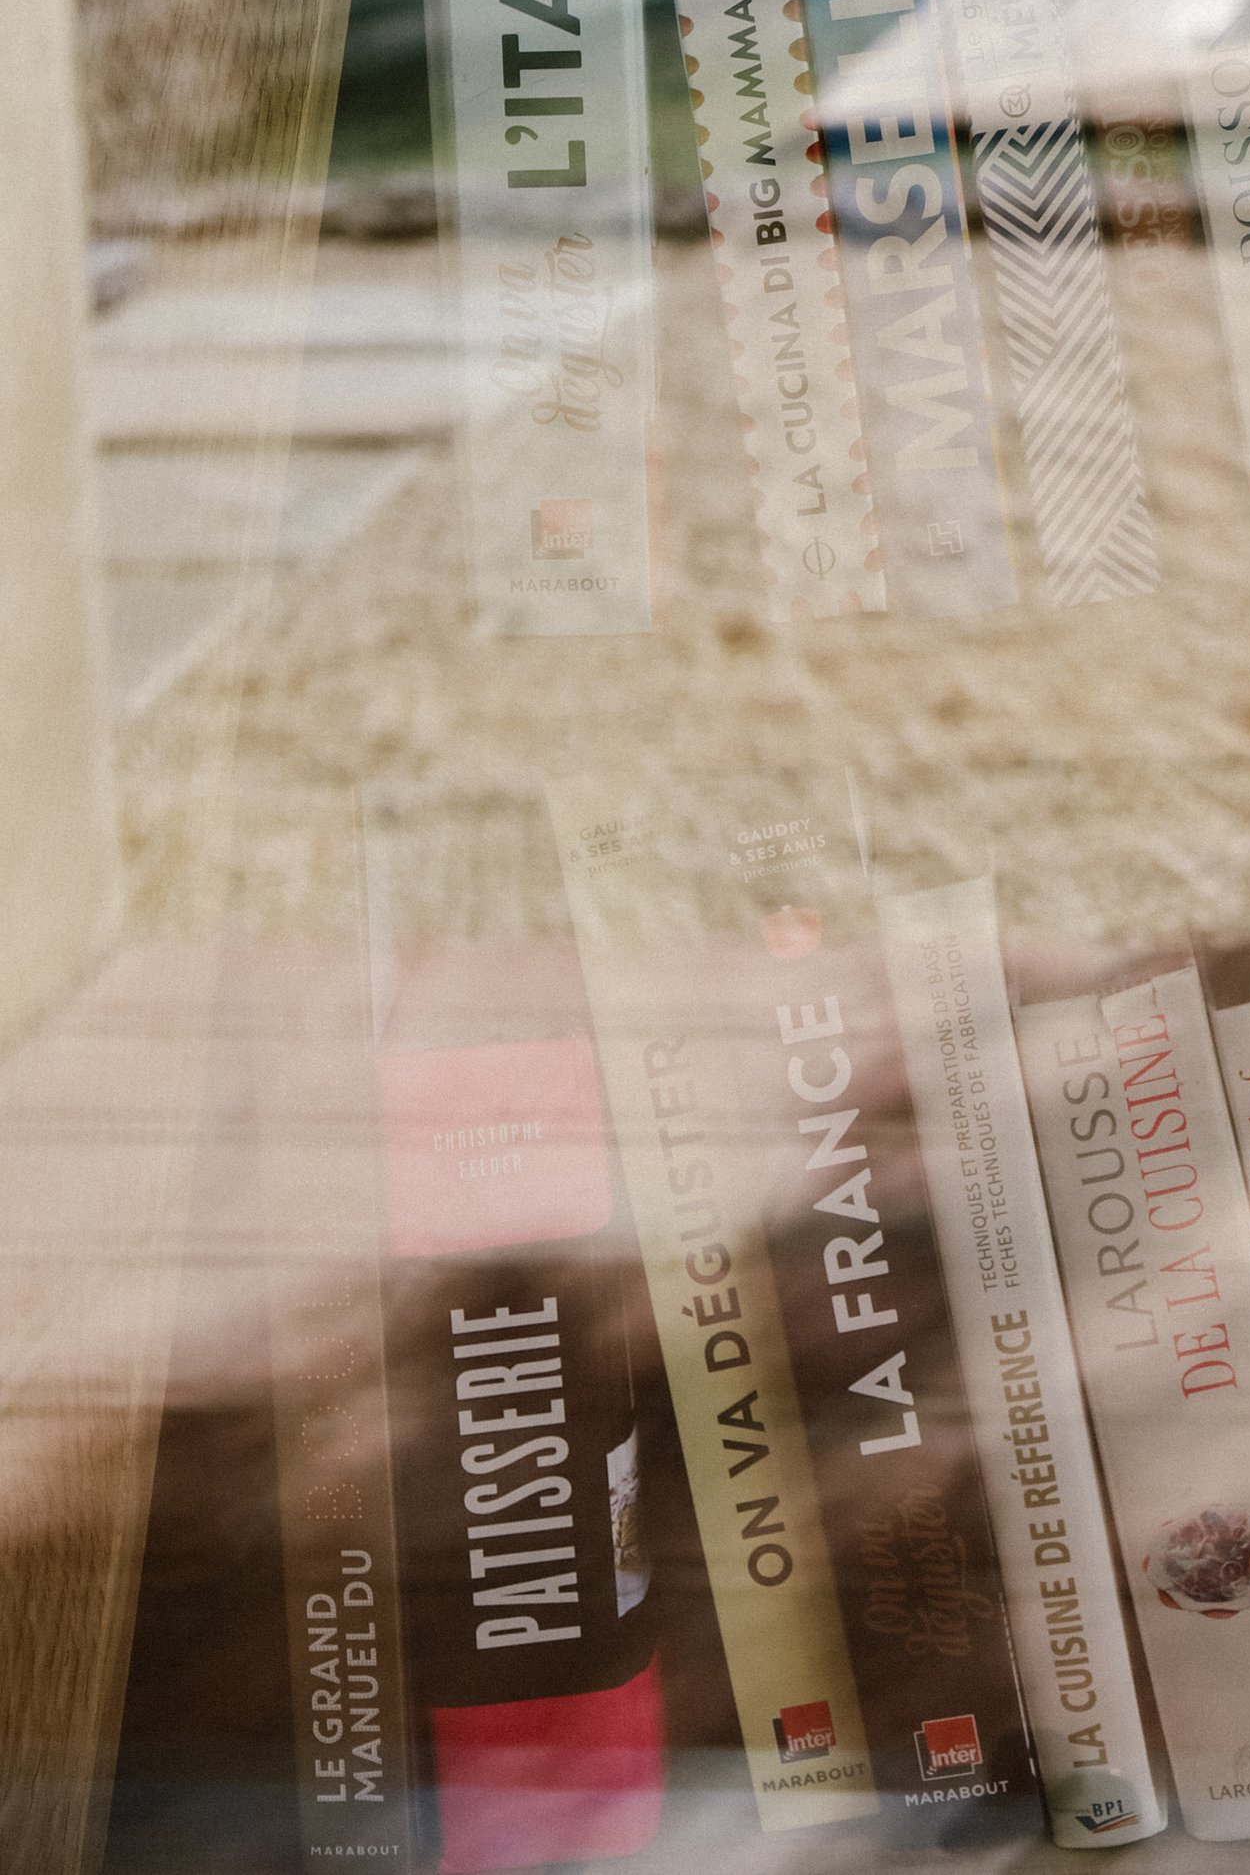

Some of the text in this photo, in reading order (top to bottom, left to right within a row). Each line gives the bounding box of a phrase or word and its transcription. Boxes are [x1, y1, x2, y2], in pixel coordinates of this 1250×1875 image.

[749, 177, 788, 247] BIG
[762, 256, 794, 295] DI
[770, 301, 816, 455] CUCINA
[792, 463, 828, 517] LA
[510, 577, 620, 594] MARABOUT
[737, 817, 811, 845] GAUDRY
[745, 844, 777, 864] SES
[781, 834, 826, 857] AMIS
[922, 940, 998, 1293] TECHNIQUES ET PRÉPARATIONS DE BASE
[945, 933, 1020, 1289] FICHES TECHNIQUES DE FABRICATION
[775, 995, 923, 1456] LA FRANCE
[1056, 1034, 1161, 1353] LAROUSSE
[1114, 1011, 1240, 1400] DE LA CUISINE
[643, 1036, 794, 1588] ON VA DÉGUSTER
[450, 1296, 582, 1651] PATISSERIE
[990, 1308, 1109, 1770] LA CUISINE DE RÉFÉRENCE
[305, 1591, 348, 1804] LE GRAND
[340, 1548, 385, 1804] MANUEL DU
[761, 1762, 868, 1793] MARABOUT
[786, 1731, 834, 1753] inter
[904, 1780, 1010, 1808] MARABOUT
[929, 1747, 977, 1767] inter
[309, 1844, 400, 1858] MARABOUT
